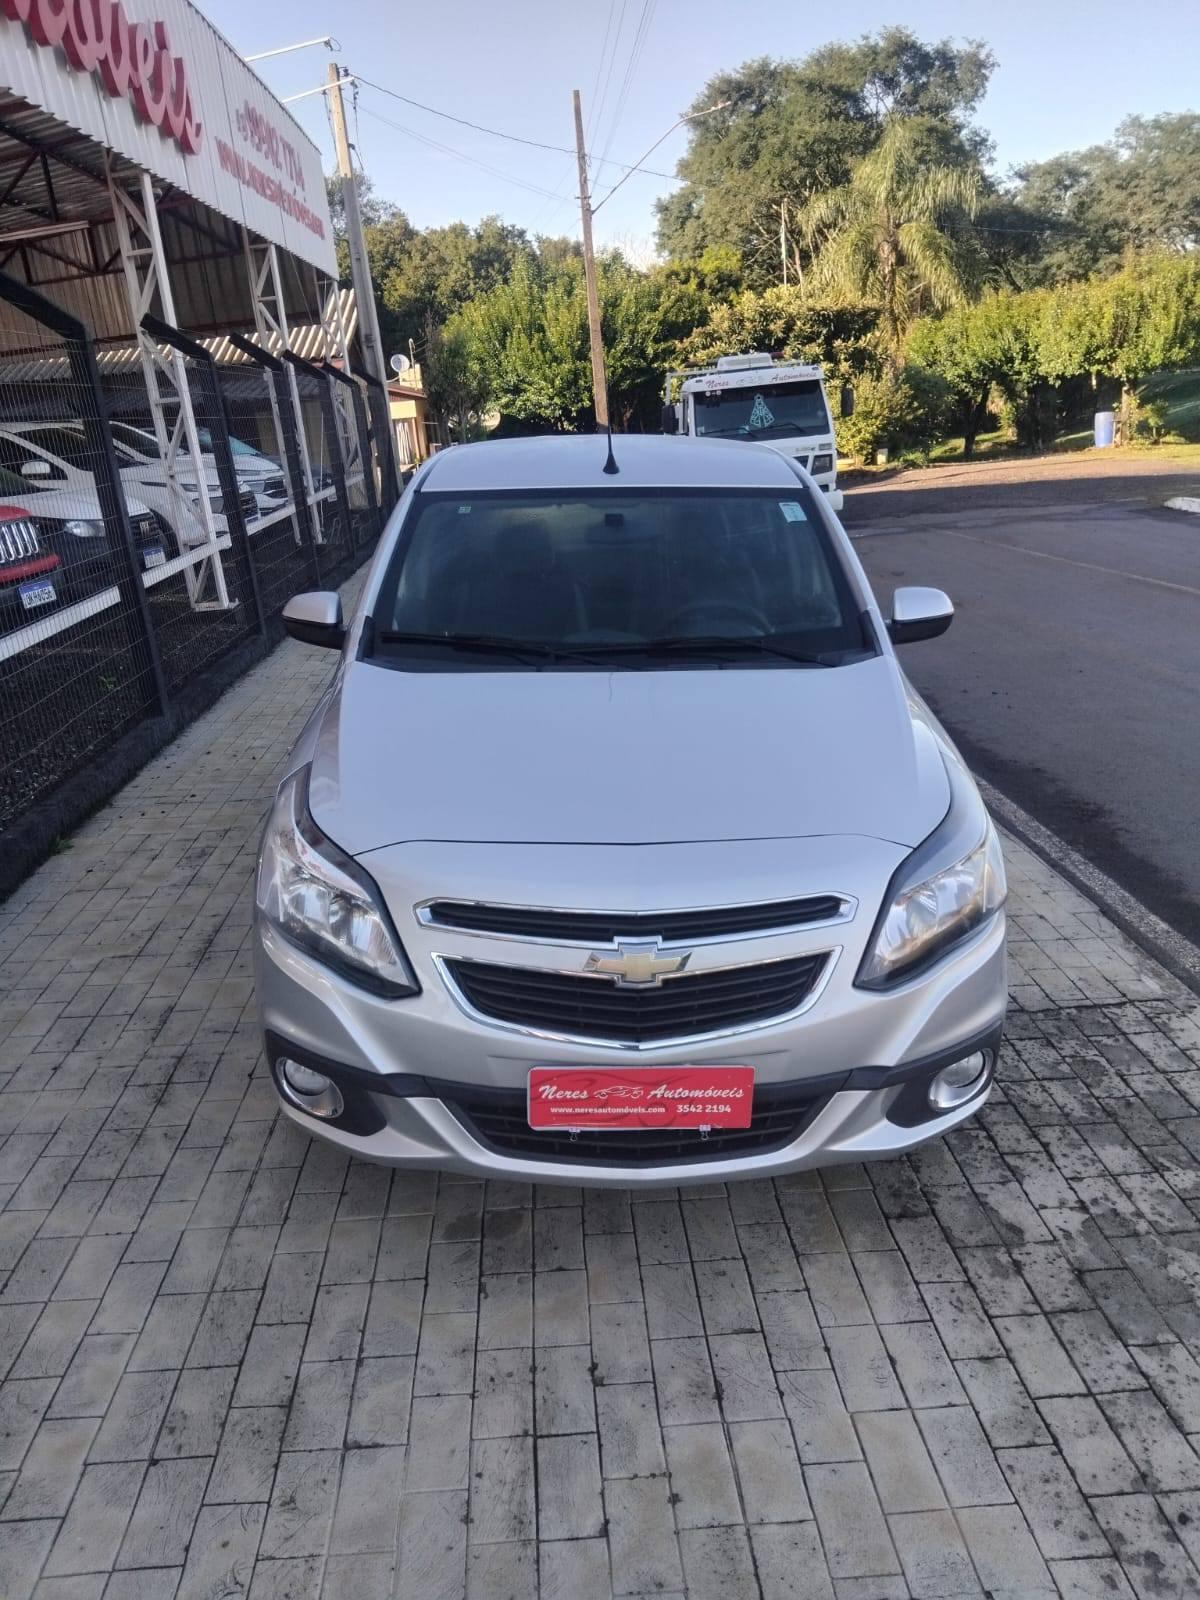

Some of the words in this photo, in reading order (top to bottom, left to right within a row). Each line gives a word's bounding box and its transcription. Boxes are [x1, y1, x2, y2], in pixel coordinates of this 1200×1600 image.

[538, 1085, 589, 1100] Neres
[646, 1084, 745, 1099] Automóveis
[676, 1104, 703, 1113] 3542
[705, 1104, 732, 1113] 2194
